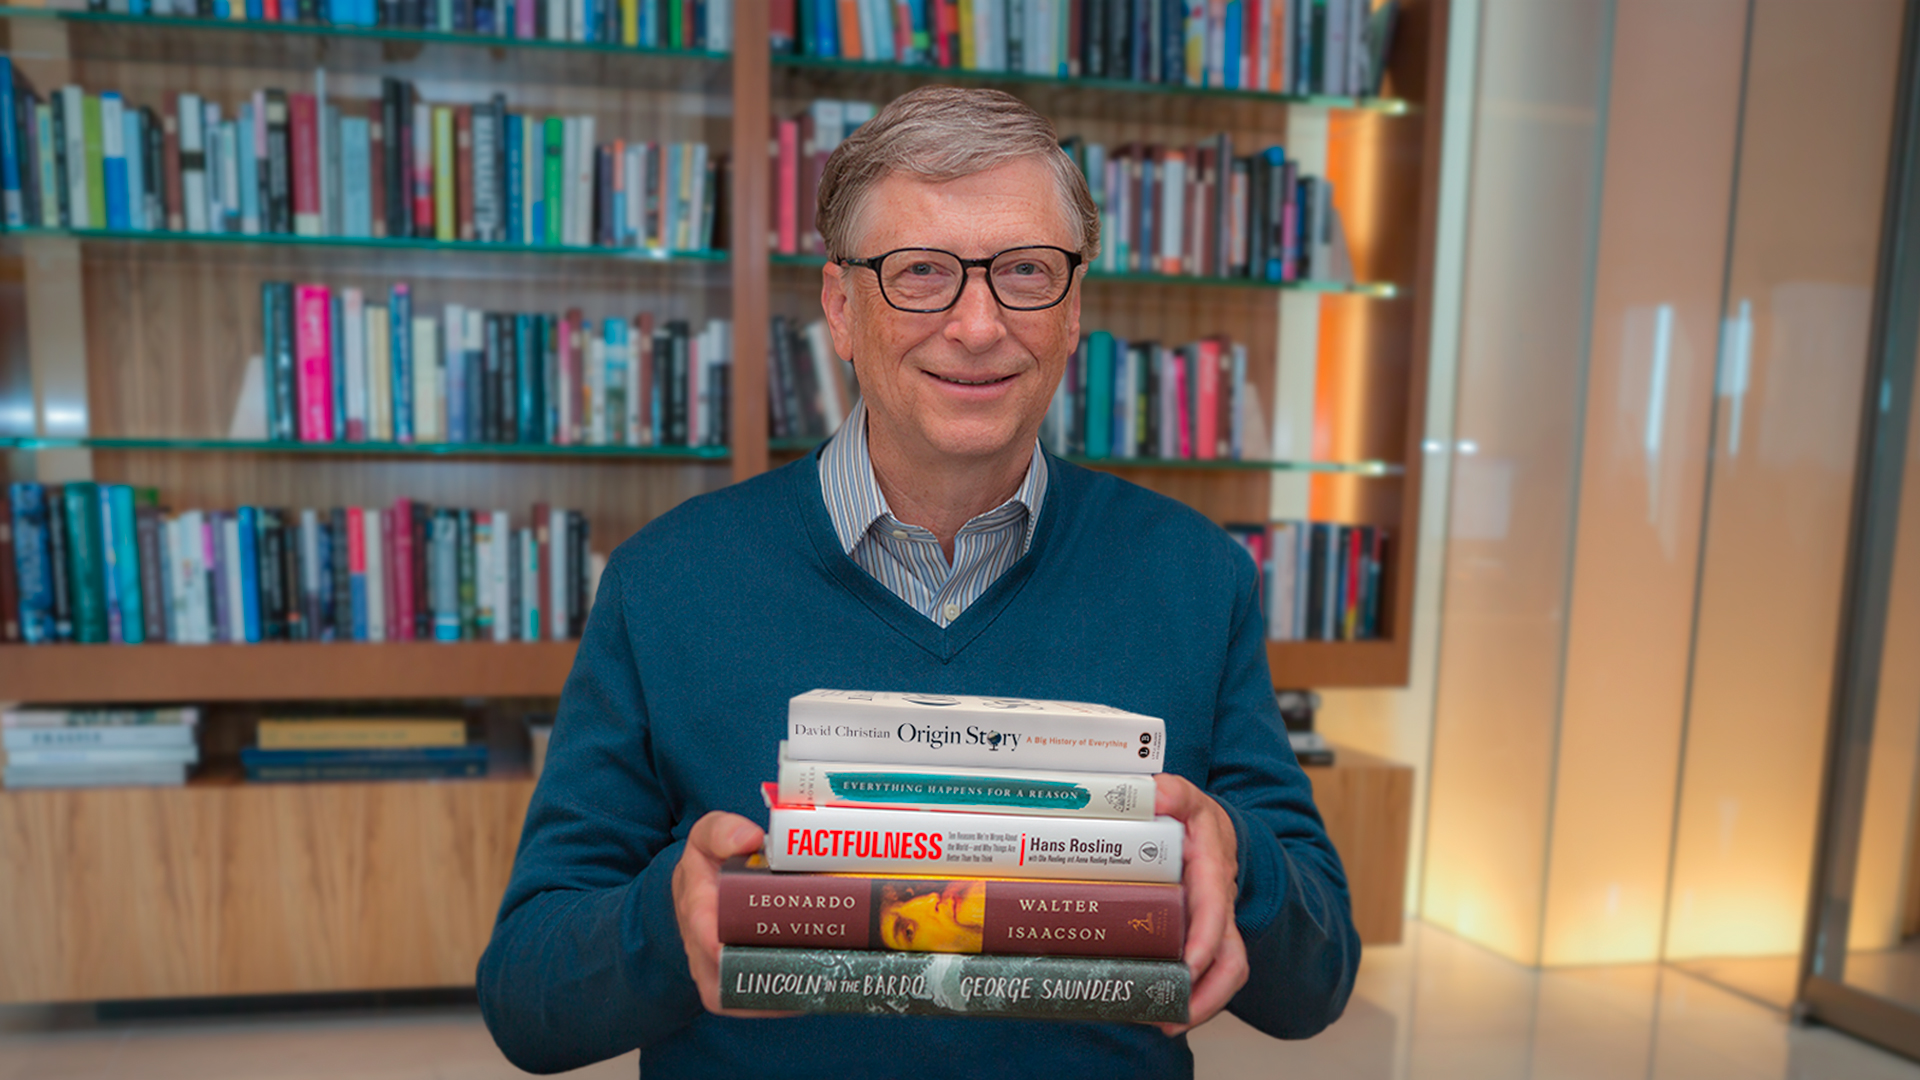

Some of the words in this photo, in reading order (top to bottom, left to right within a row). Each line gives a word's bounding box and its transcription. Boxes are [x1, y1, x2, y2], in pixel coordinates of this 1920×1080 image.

[795, 724, 831, 736] David
[835, 725, 891, 739] Christian
[897, 722, 962, 749] Origin
[1026, 736, 1032, 744] A
[1034, 736, 1048, 746] Big
[1049, 736, 1077, 748] History
[1088, 738, 1128, 749] Everything
[843, 781, 922, 793] EVERYTHING
[928, 785, 983, 795] HAPPENS
[987, 787, 1011, 797] FOR
[1016, 789, 1024, 798] A
[1029, 790, 1078, 800] REASON
[787, 828, 943, 860] FACTFULNESS
[1030, 837, 1066, 852] Hans
[1069, 838, 1122, 857] Rosling
[749, 894, 856, 909] LEONARDO
[1019, 898, 1100, 913] WALTER
[756, 922, 781, 935] DA
[790, 923, 846, 936] VINCI
[1007, 926, 1107, 941] ISAACSON
[735, 972, 823, 995] LINCOLN
[824, 979, 838, 993] IN
[840, 979, 862, 994] THE
[863, 974, 926, 997] BARDO
[959, 976, 1034, 1003] GEORGE
[1040, 978, 1135, 1002] SAUNDERS
